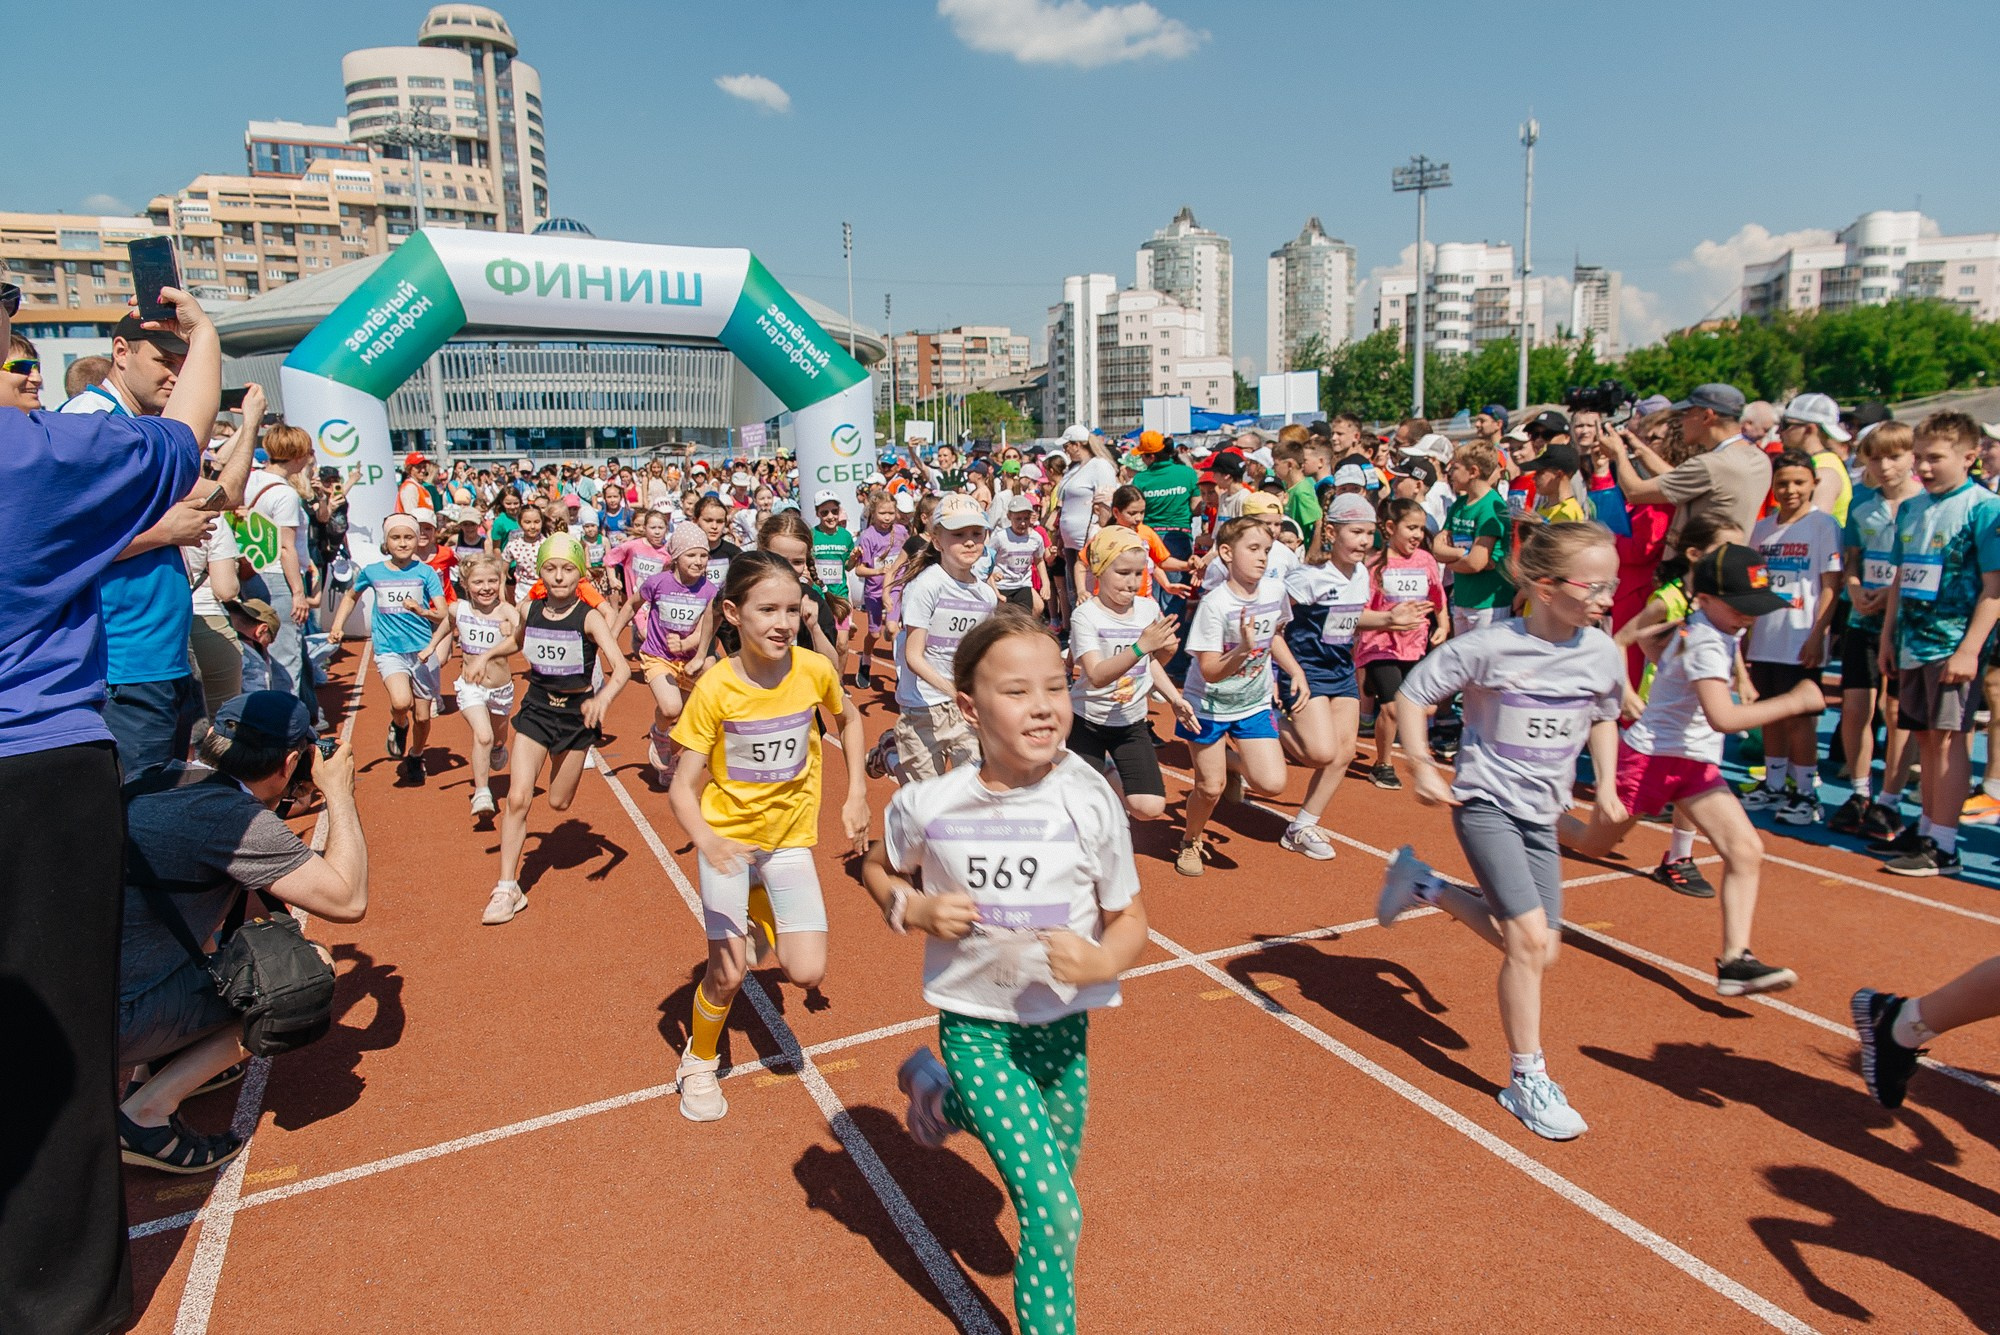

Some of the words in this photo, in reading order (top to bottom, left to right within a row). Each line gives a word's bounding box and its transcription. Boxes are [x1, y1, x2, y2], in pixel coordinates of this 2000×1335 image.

[485, 257, 703, 307] ФИНИШ
[344, 279, 418, 352] зелёный
[360, 295, 433, 365] марафон
[767, 303, 831, 368] зелёный
[756, 314, 820, 380] марафон
[816, 463, 874, 483] СБЕР
[639, 562, 655, 572] 002
[706, 570, 719, 579] 58
[823, 567, 838, 576] 506
[1397, 580, 1418, 592] 262
[388, 591, 412, 602] 566
[670, 608, 694, 621] 052
[949, 616, 977, 632] 302
[1252, 619, 1270, 636] 92
[469, 629, 494, 643] 510
[537, 645, 566, 660] 359
[752, 738, 796, 763] 579
[967, 856, 1038, 890] 569
